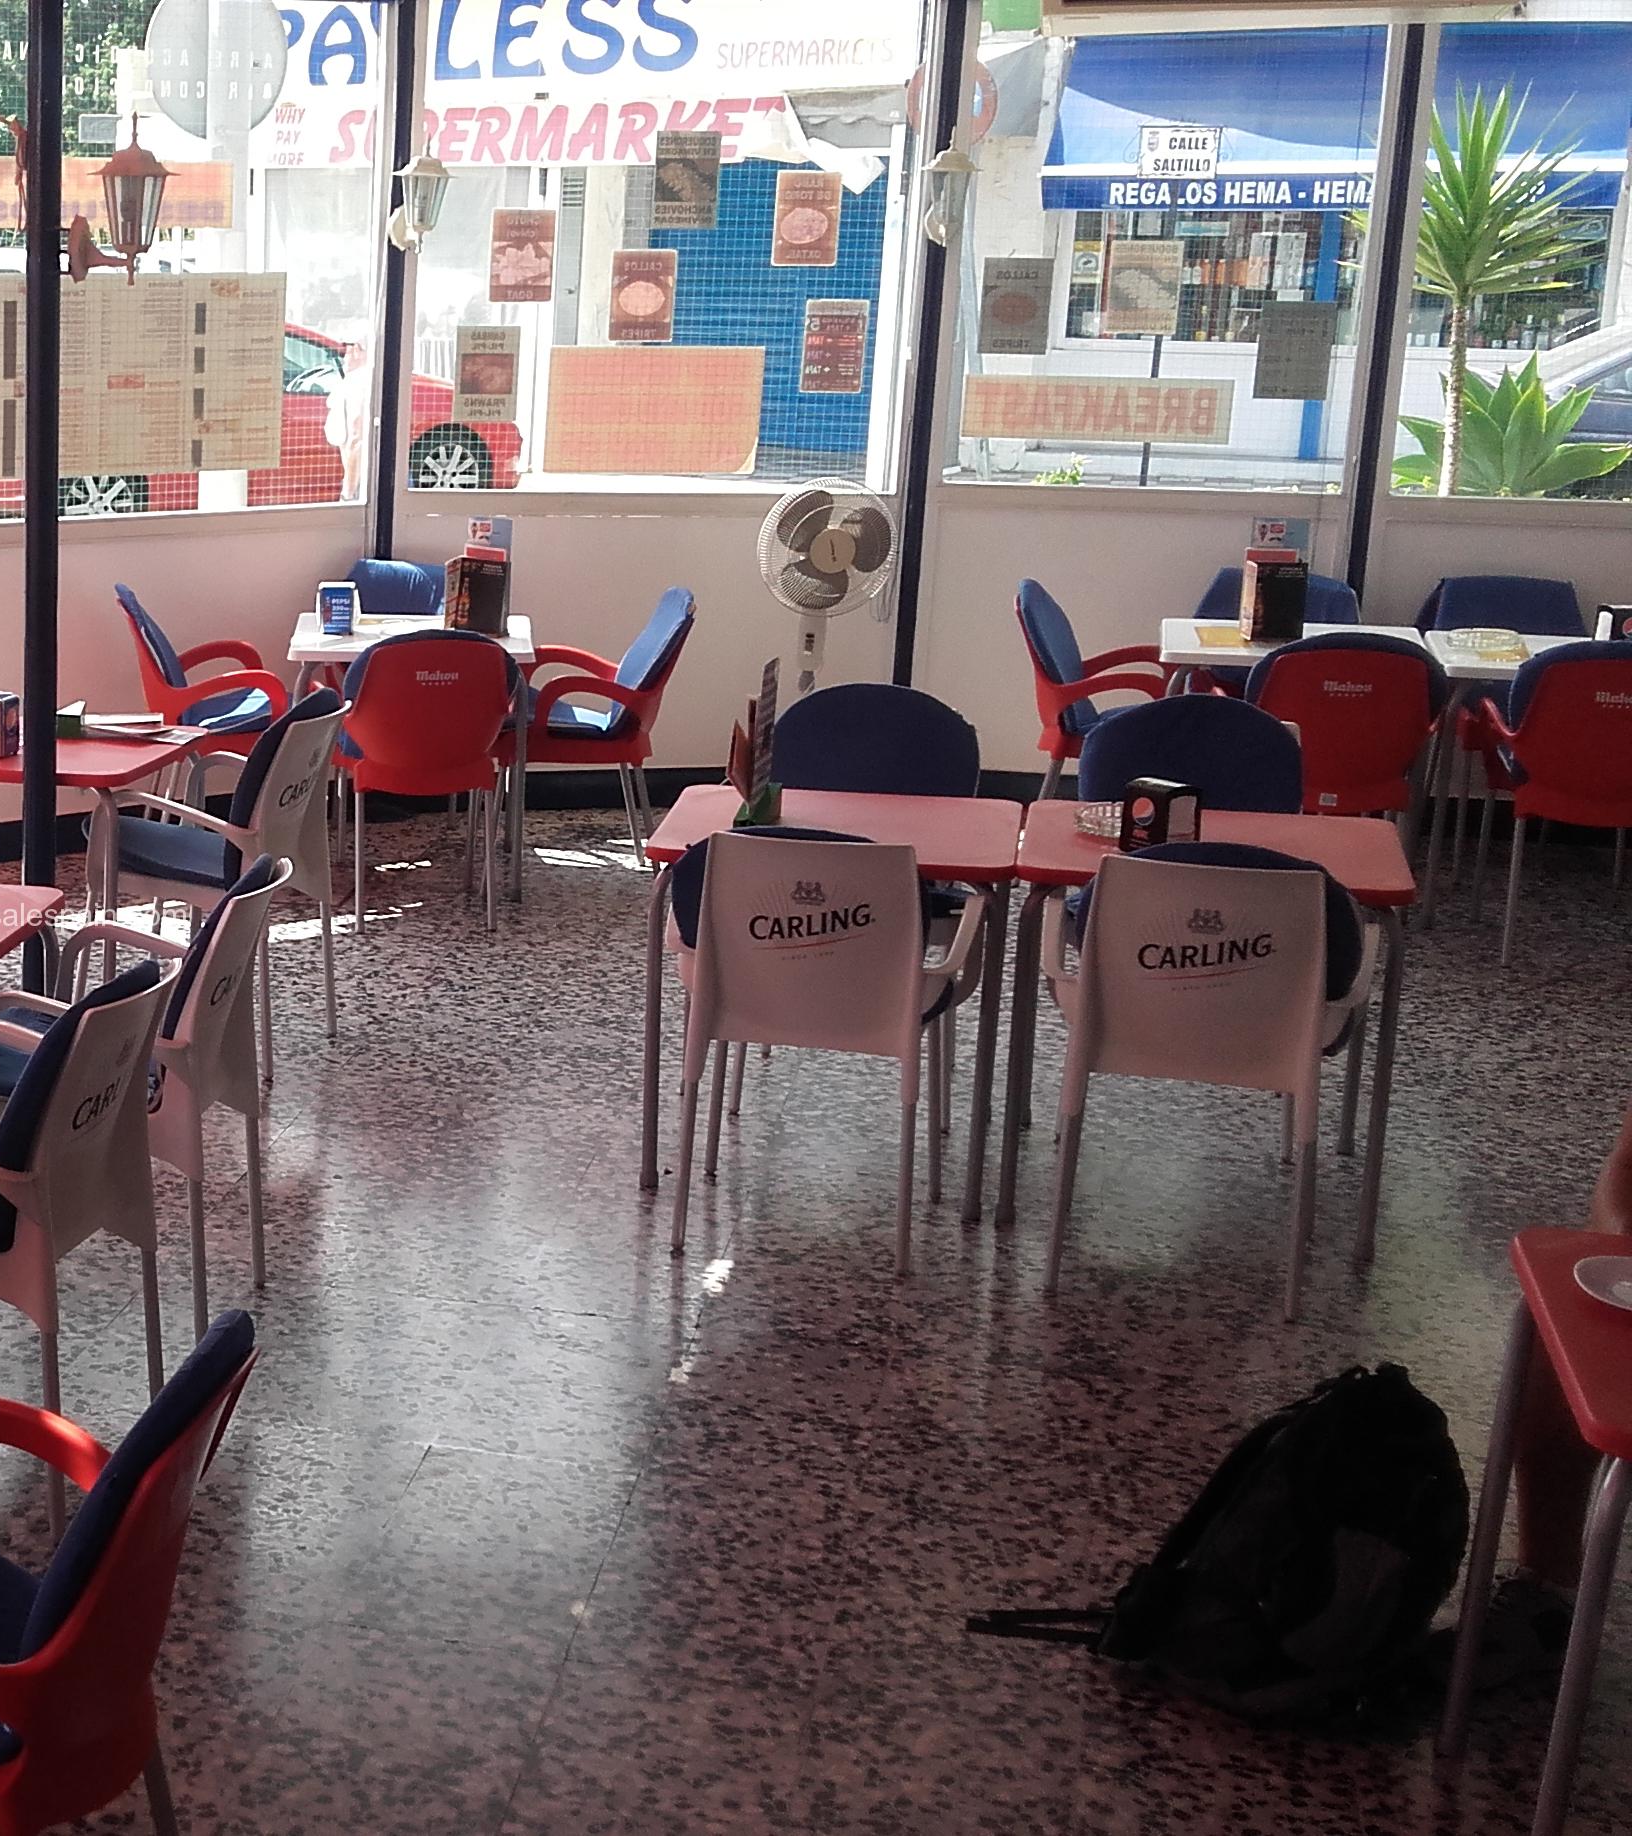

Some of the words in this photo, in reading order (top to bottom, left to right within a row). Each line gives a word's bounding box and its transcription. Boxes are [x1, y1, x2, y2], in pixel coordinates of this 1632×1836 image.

[275, 107, 306, 124] WHY
[276, 131, 301, 144] PAY
[1169, 137, 1208, 150] CALLE
[271, 152, 304, 165] ORE
[1153, 158, 1211, 172] SALTILLO
[1109, 181, 1217, 205] REGAOS
[1224, 181, 1292, 205] HEMA
[749, 903, 871, 940] CARLING
[1137, 933, 1273, 970] CARLING
